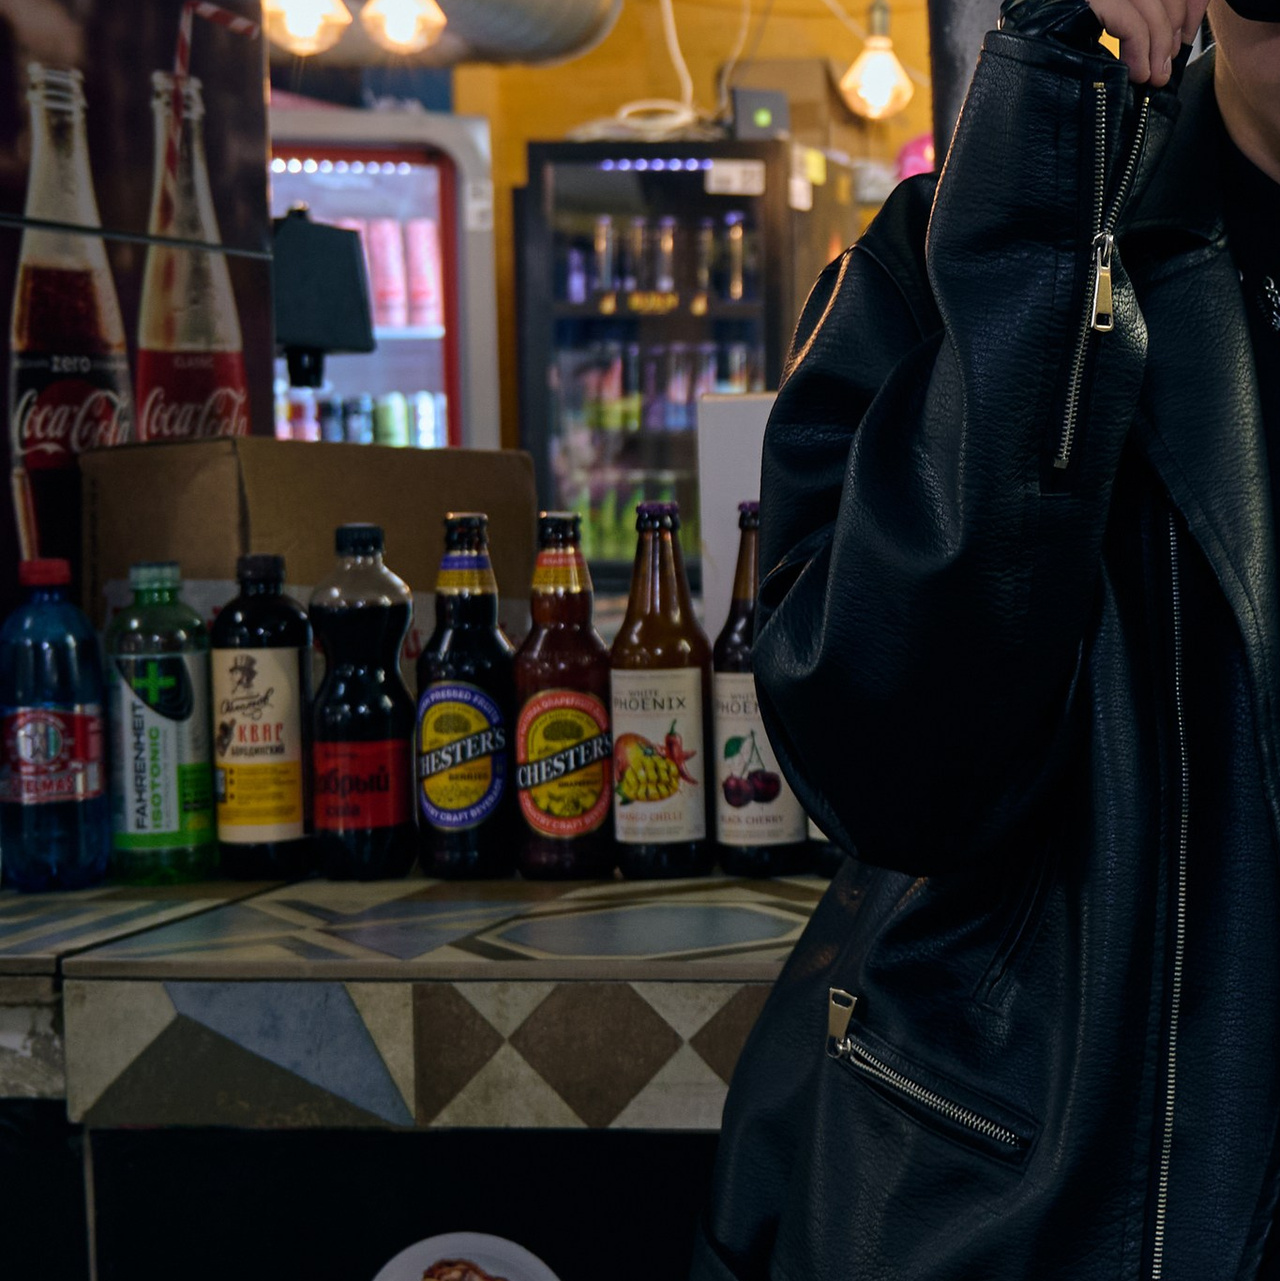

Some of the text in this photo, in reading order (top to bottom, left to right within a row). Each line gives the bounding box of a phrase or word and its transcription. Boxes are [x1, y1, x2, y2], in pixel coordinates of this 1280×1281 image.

[50, 355, 91, 374] zero
[614, 697, 687, 711] PHOENIX
[134, 701, 148, 831] FAHRENHEIT
[147, 725, 163, 829] ISOTONIC
[419, 725, 507, 779] HESTER'S
